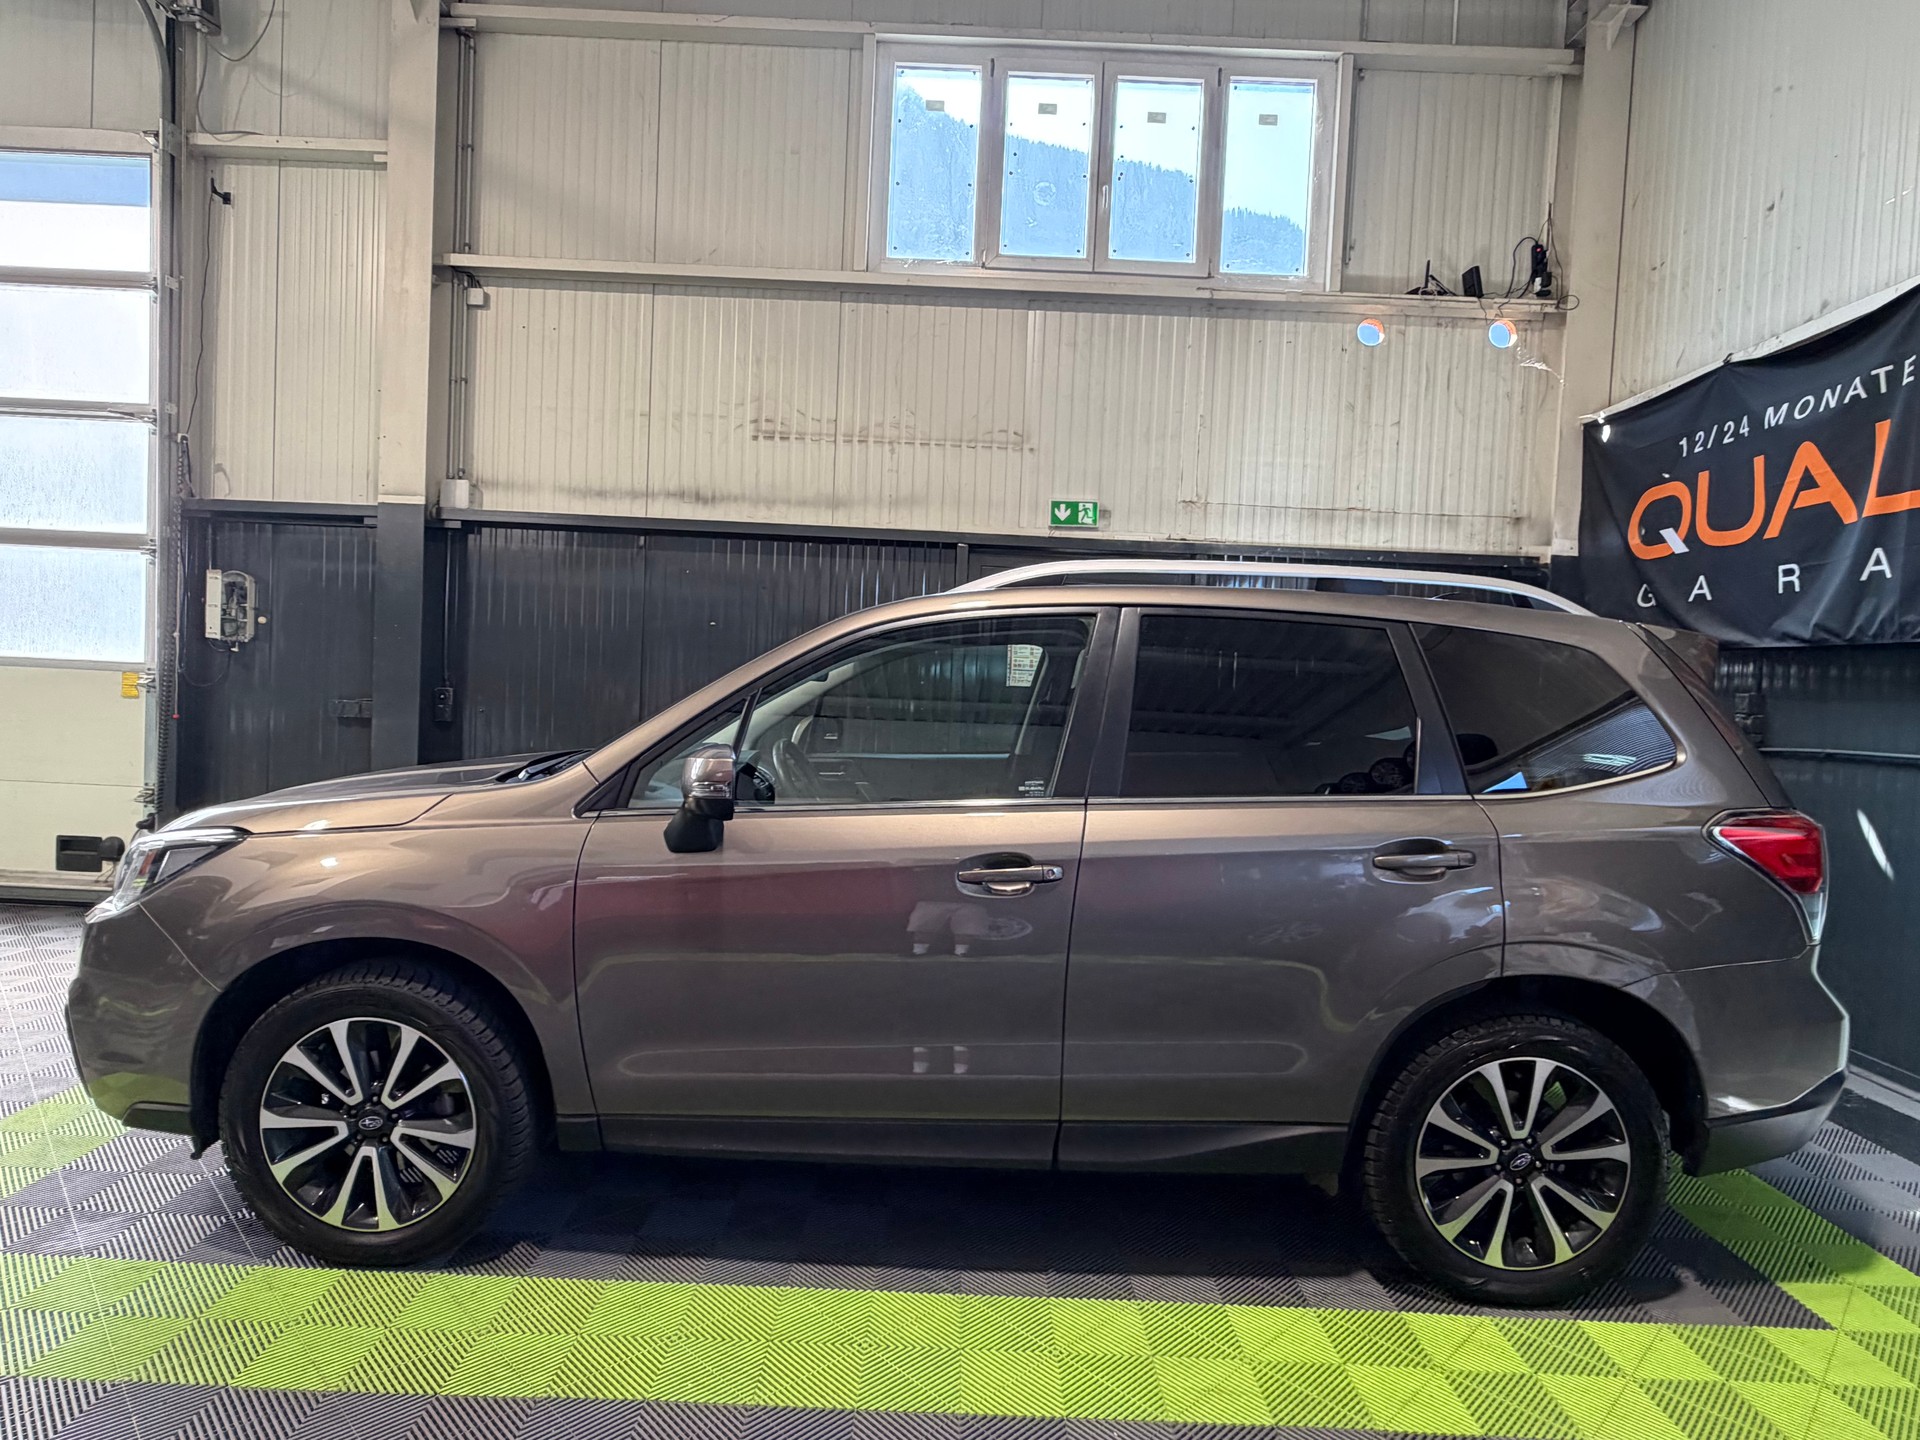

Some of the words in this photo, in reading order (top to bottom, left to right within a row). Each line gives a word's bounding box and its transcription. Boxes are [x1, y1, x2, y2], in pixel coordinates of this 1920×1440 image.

[1679, 415, 1750, 457] 12/24
[1763, 355, 1917, 429] MONATE
[1627, 419, 1920, 560] QUAL
